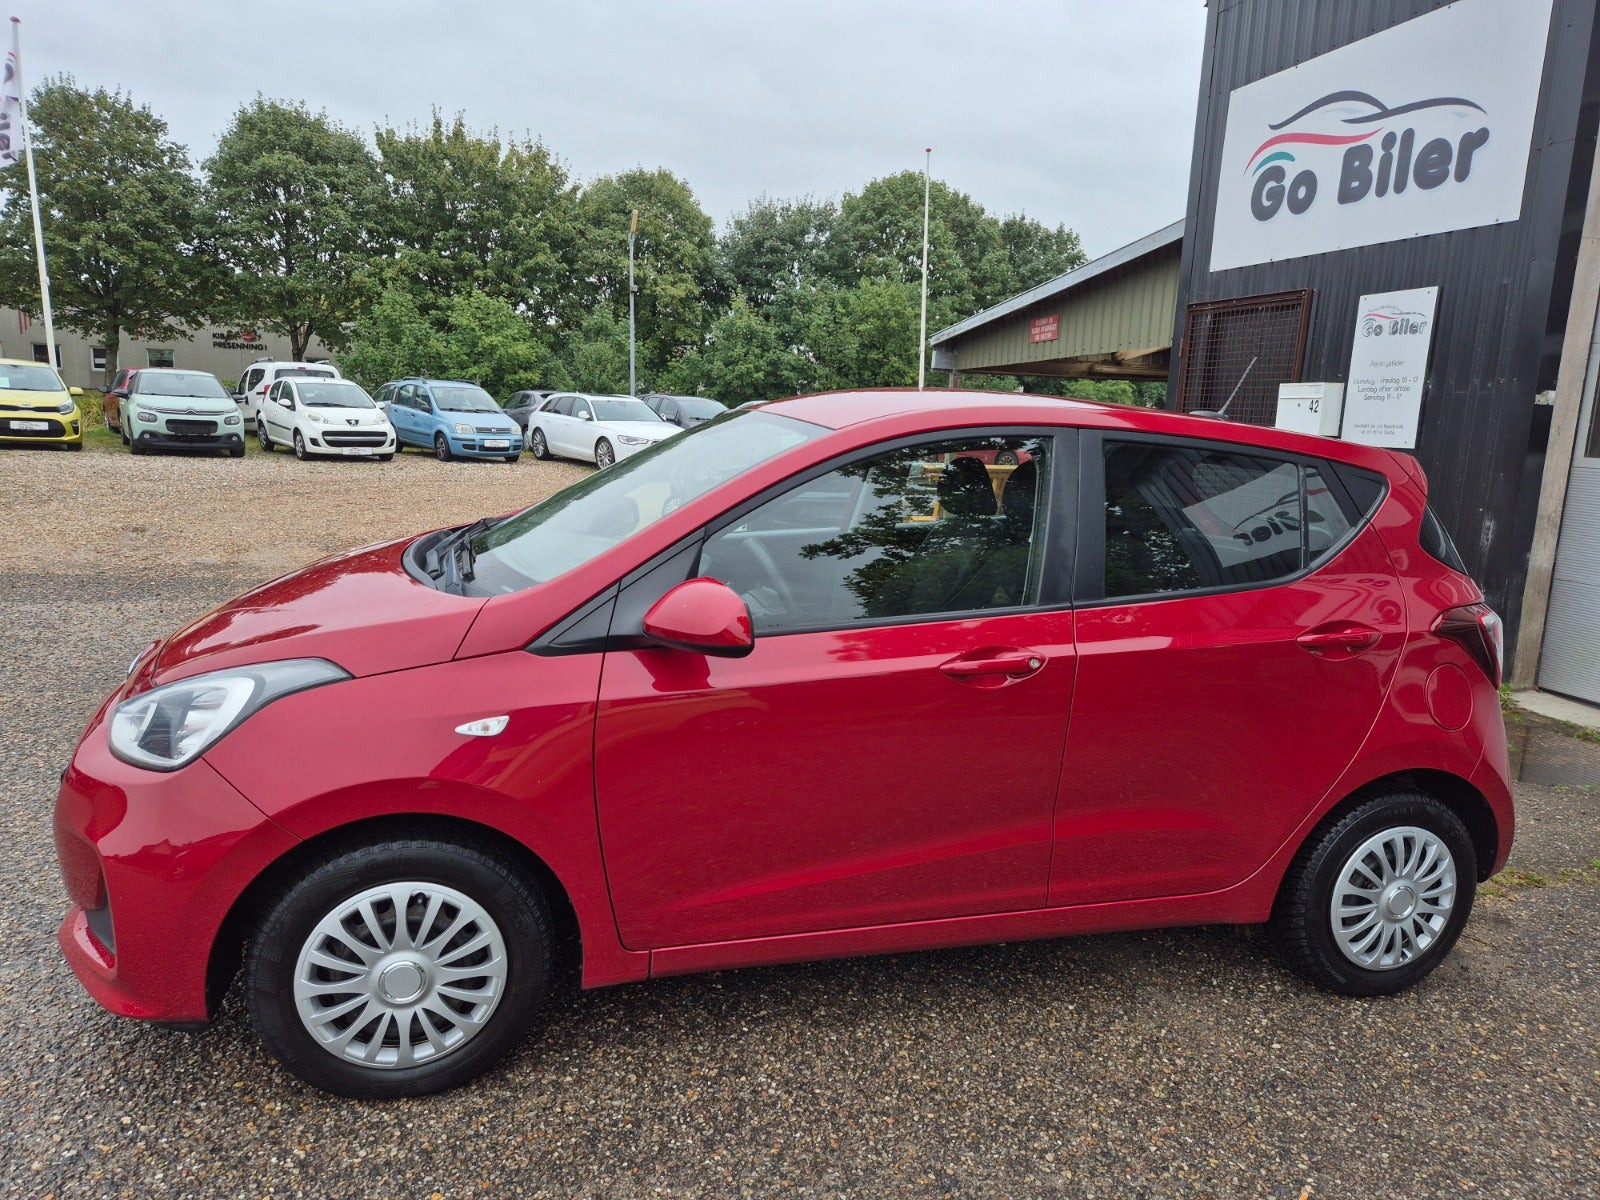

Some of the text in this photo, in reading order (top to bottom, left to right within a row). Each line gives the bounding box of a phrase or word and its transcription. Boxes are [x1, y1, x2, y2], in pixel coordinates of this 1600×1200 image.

[1250, 126, 1490, 222] Go Biler
[1362, 318, 1428, 337] Go Biler
[1309, 399, 1320, 413] 42
